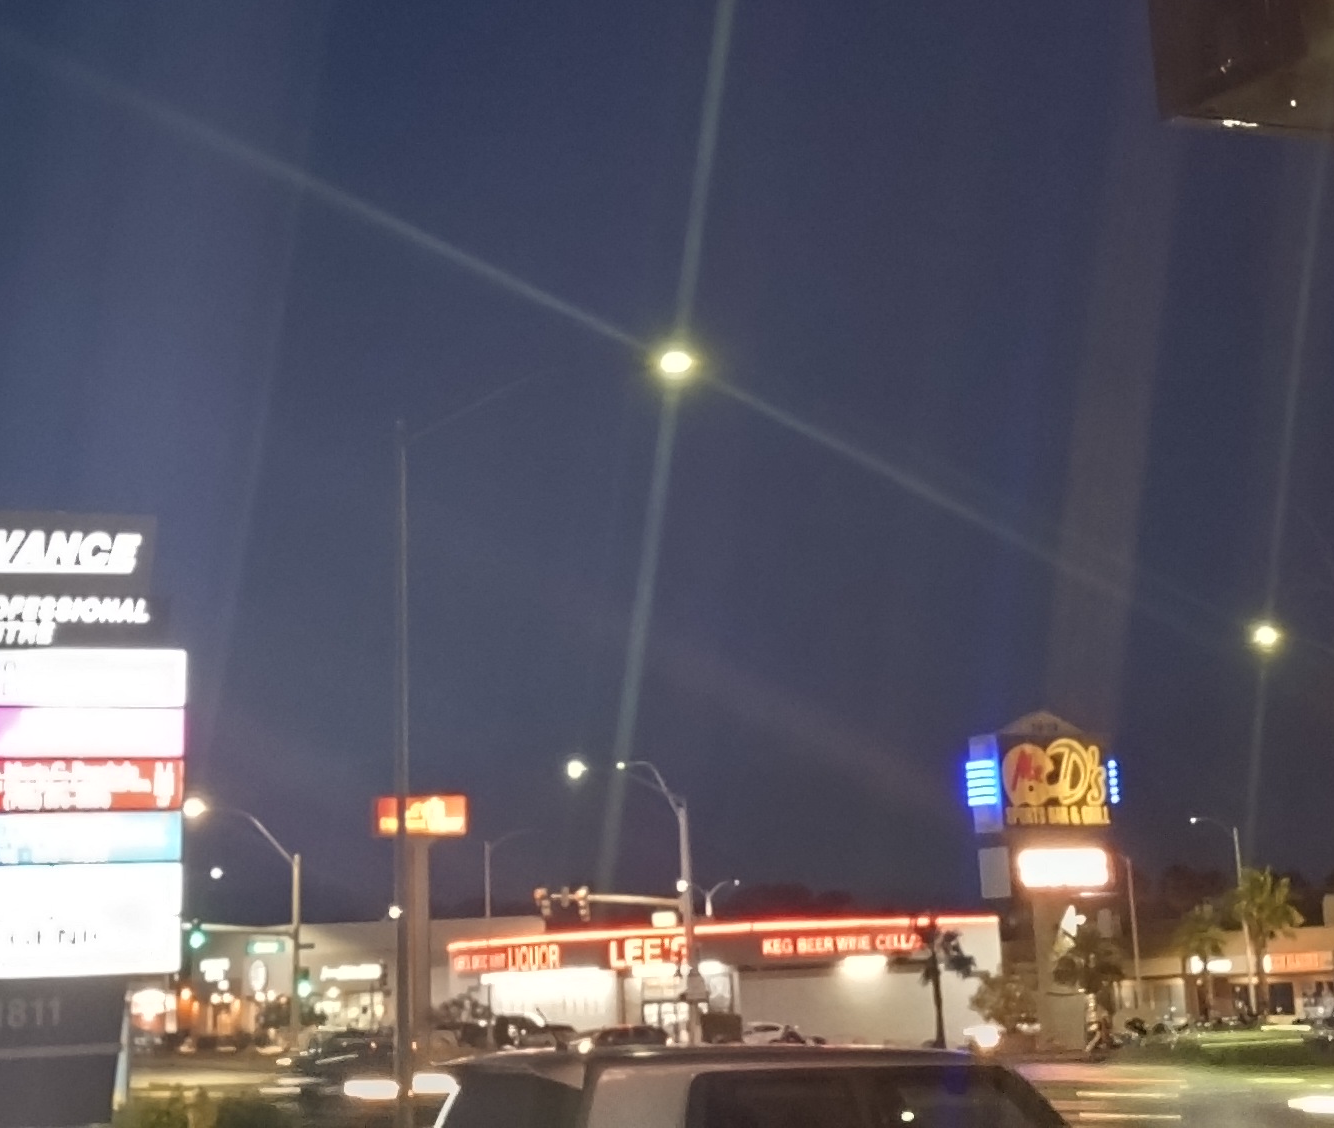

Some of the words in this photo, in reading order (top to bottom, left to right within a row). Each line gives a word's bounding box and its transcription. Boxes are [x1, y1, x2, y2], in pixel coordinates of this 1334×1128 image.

[762, 938, 794, 956] KEG
[796, 936, 835, 955] BEER
[835, 934, 871, 953] WINE
[508, 944, 561, 972] LIQUOR
